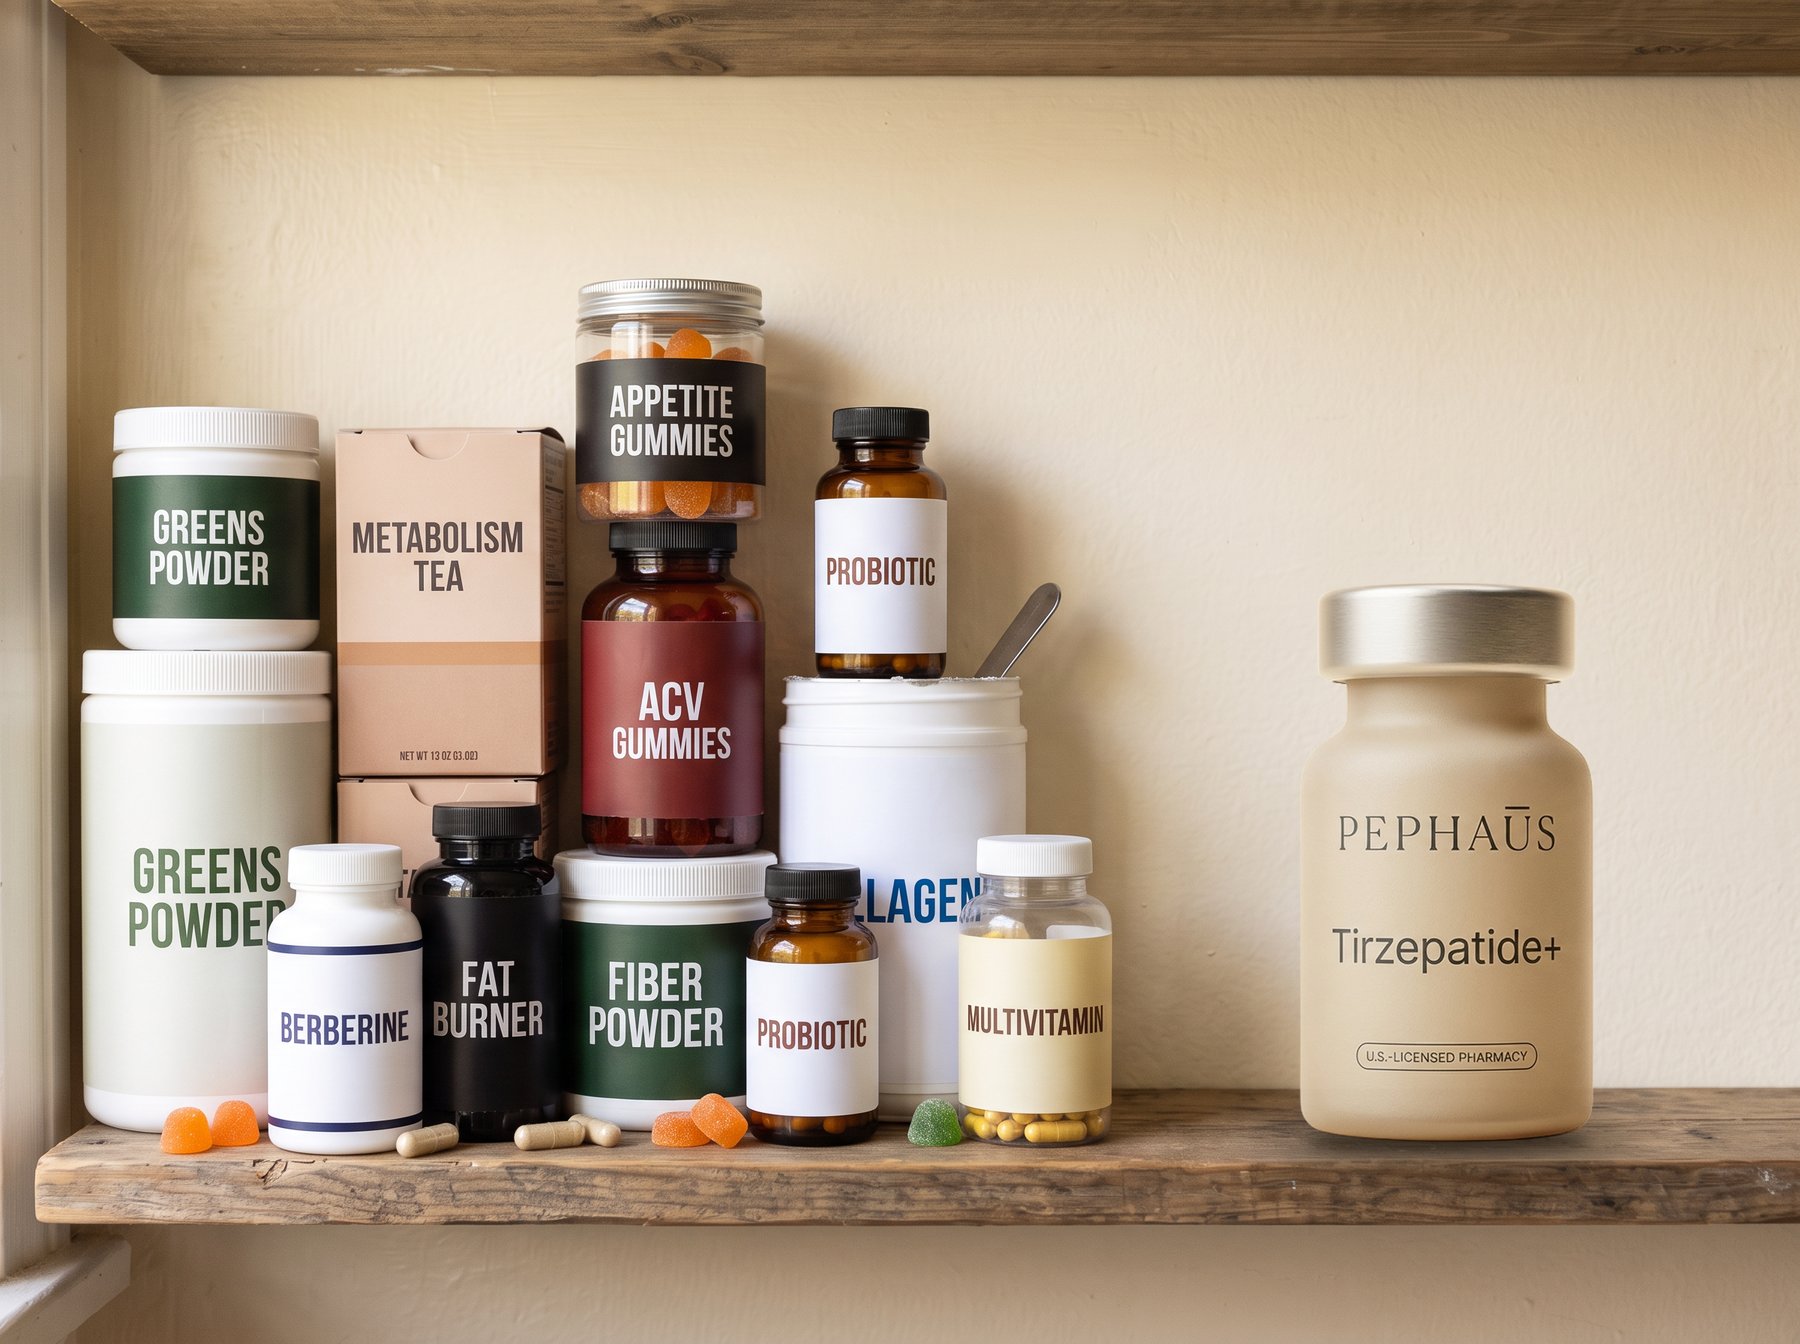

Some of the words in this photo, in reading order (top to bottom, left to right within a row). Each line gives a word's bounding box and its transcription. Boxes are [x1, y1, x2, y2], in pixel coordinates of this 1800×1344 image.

[610, 384, 733, 418] APPETITE
[610, 423, 733, 457] GUMMIES
[154, 509, 264, 545] GREENS
[353, 521, 523, 554] METABOLISM
[150, 550, 268, 586] POWDER
[414, 560, 463, 592] TEA
[826, 556, 937, 586] PROBIOTIC
[639, 681, 704, 722] ACV
[399, 750, 414, 761] NET
[416, 750, 428, 761] WT
[441, 750, 451, 761] OZ
[613, 727, 731, 760] GUMMIES
[1339, 806, 1556, 851] PEPHAŪS
[133, 846, 281, 894] GREENS
[1332, 928, 1561, 974] Tirzepatide+
[462, 961, 515, 997] FAT
[608, 961, 702, 1002] FIBER
[280, 1009, 409, 1045] BERBERINE
[433, 1001, 543, 1039] BURNER
[589, 1006, 723, 1049] POWDER
[757, 1017, 867, 1051] PROBIOTIC
[967, 1004, 1104, 1036] MULTIVITAMIN
[1366, 1050, 1455, 1064] U.S.-LICENSED
[1459, 1050, 1528, 1063] PHARMACY
